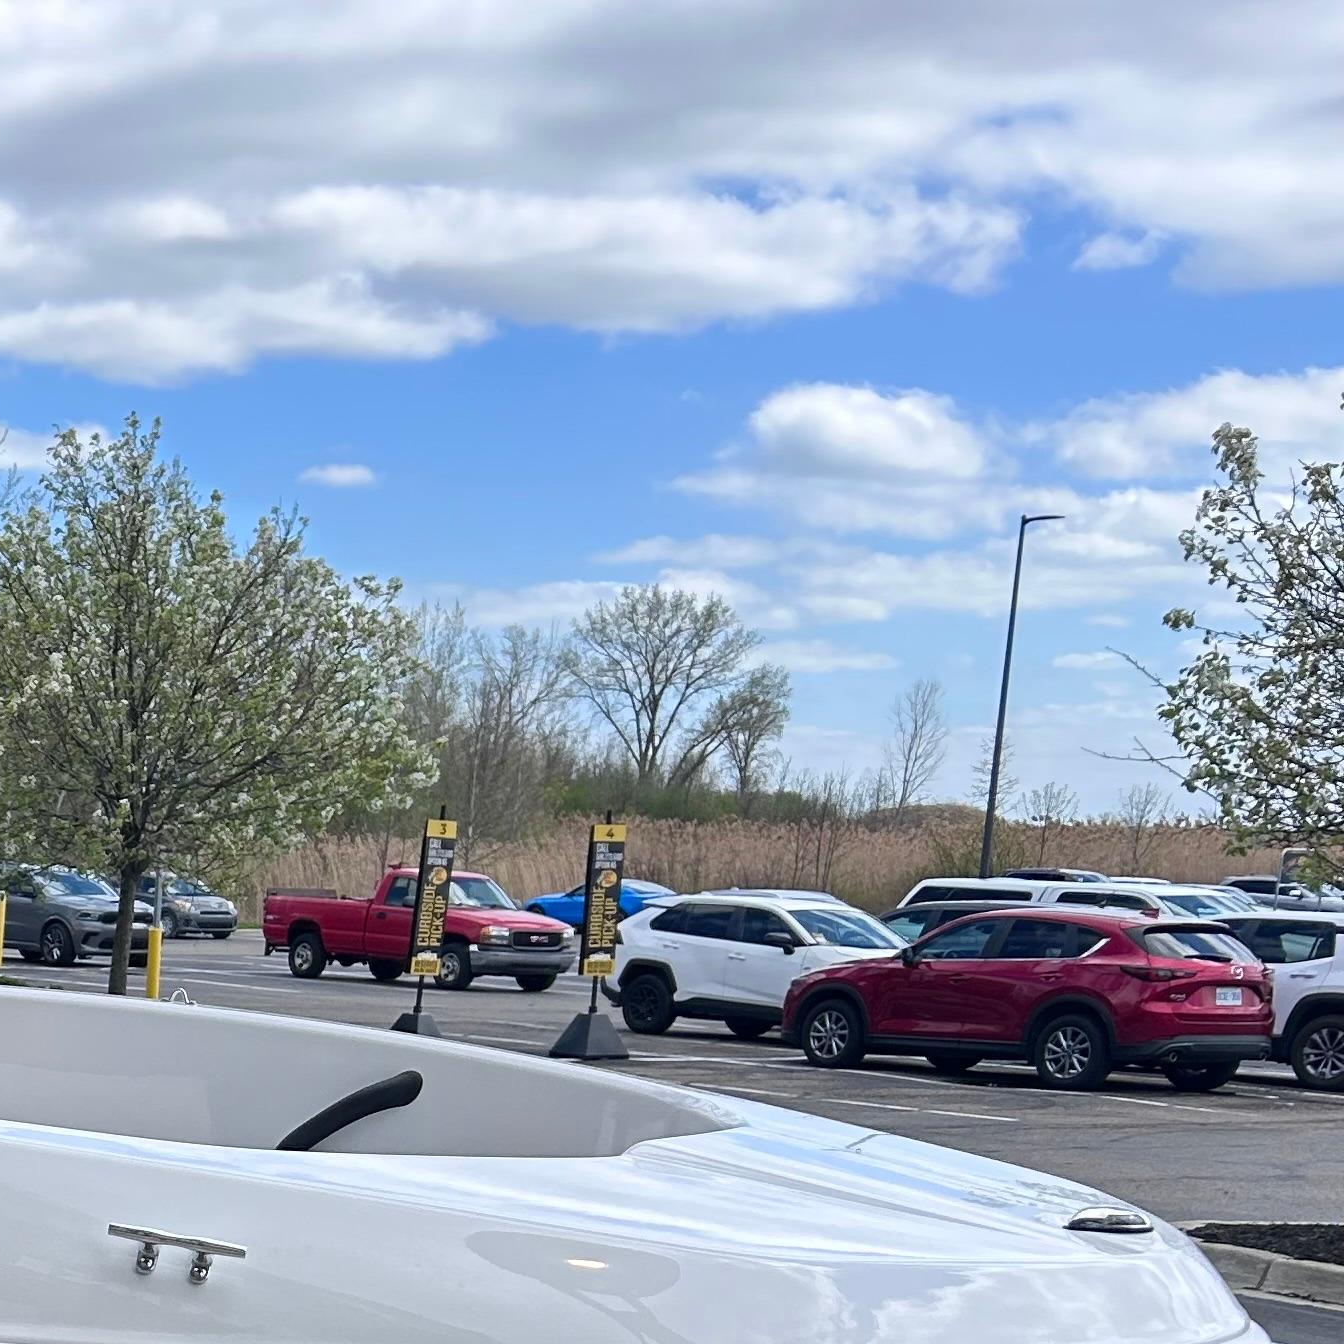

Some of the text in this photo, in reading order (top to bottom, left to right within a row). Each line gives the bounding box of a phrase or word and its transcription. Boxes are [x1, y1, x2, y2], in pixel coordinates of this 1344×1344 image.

[439, 822, 448, 836] 3
[606, 828, 615, 840] 4
[417, 882, 437, 946] CURBSIDE
[429, 895, 447, 947] PICK-UP
[588, 885, 607, 948] CURBSIDE
[601, 897, 618, 948] PICK-UP
